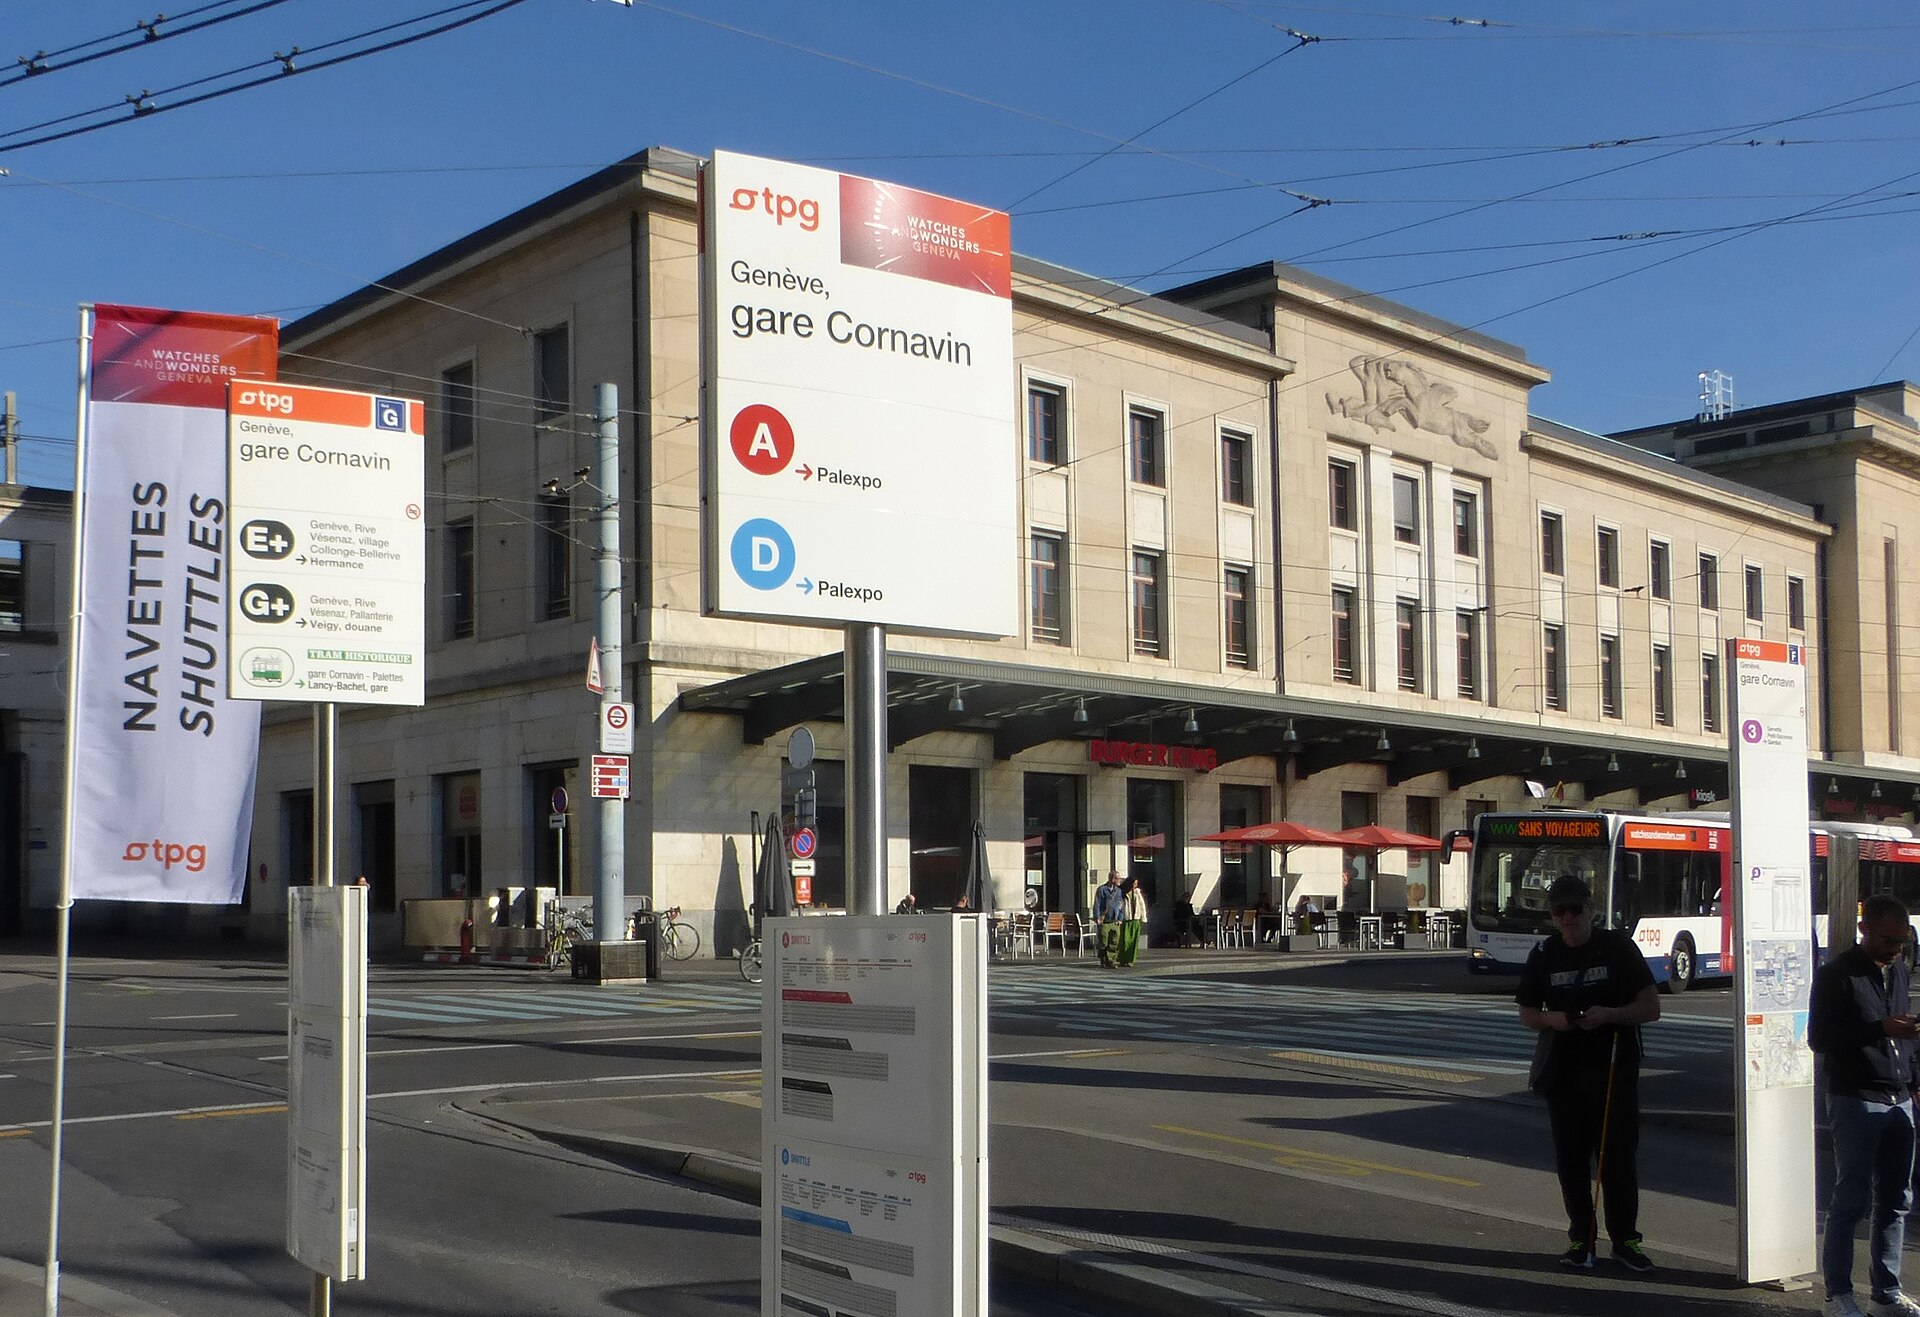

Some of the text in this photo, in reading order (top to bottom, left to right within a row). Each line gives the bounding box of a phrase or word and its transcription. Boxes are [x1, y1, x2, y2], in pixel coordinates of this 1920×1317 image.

[762, 187, 819, 232] tpg
[907, 215, 966, 239] WATCHES
[913, 241, 961, 261] GENEVA
[731, 260, 830, 300] Genève,
[731, 303, 972, 367] gare Cornavin
[153, 350, 220, 365] WATCHES
[156, 372, 213, 385] GENEVA
[259, 393, 294, 414] tpg
[383, 408, 398, 427] G
[239, 420, 294, 438] Genève,
[748, 422, 779, 458] A
[239, 441, 391, 471] gare Cornavin
[817, 466, 882, 490] Palexpo
[309, 519, 377, 534] Genève, Rive
[247, 526, 288, 553] E+
[309, 532, 390, 548] Vésenaz, village
[309, 544, 401, 561] Collonge-Bellerive
[752, 536, 780, 572] D
[309, 557, 364, 570] Hermance
[818, 580, 883, 603] Palexpo
[123, 481, 169, 732] NAVETTES
[244, 589, 290, 616] G+
[309, 595, 377, 608] Genève, Rive
[180, 492, 225, 737] SHUTTLES
[309, 607, 393, 622] Vésenaz, Pallanterie
[309, 619, 383, 633] Veigy, douane
[309, 650, 411, 664] TRAM HISTORIQUE
[1791, 651, 1796, 661] F
[307, 669, 327, 681] gare
[329, 669, 364, 681] Cornavin
[372, 672, 404, 682] Palettes
[1740, 674, 1795, 687] gare Cornavin
[307, 680, 389, 694] Lancy-Bachet, gare
[1747, 725, 1757, 739] 3
[1090, 740, 1217, 770] BURGER KING
[1518, 820, 1543, 837] SANS
[1545, 820, 1600, 838] VOYAGEURS
[153, 839, 207, 872] tpg
[1646, 926, 1661, 947] tpg
